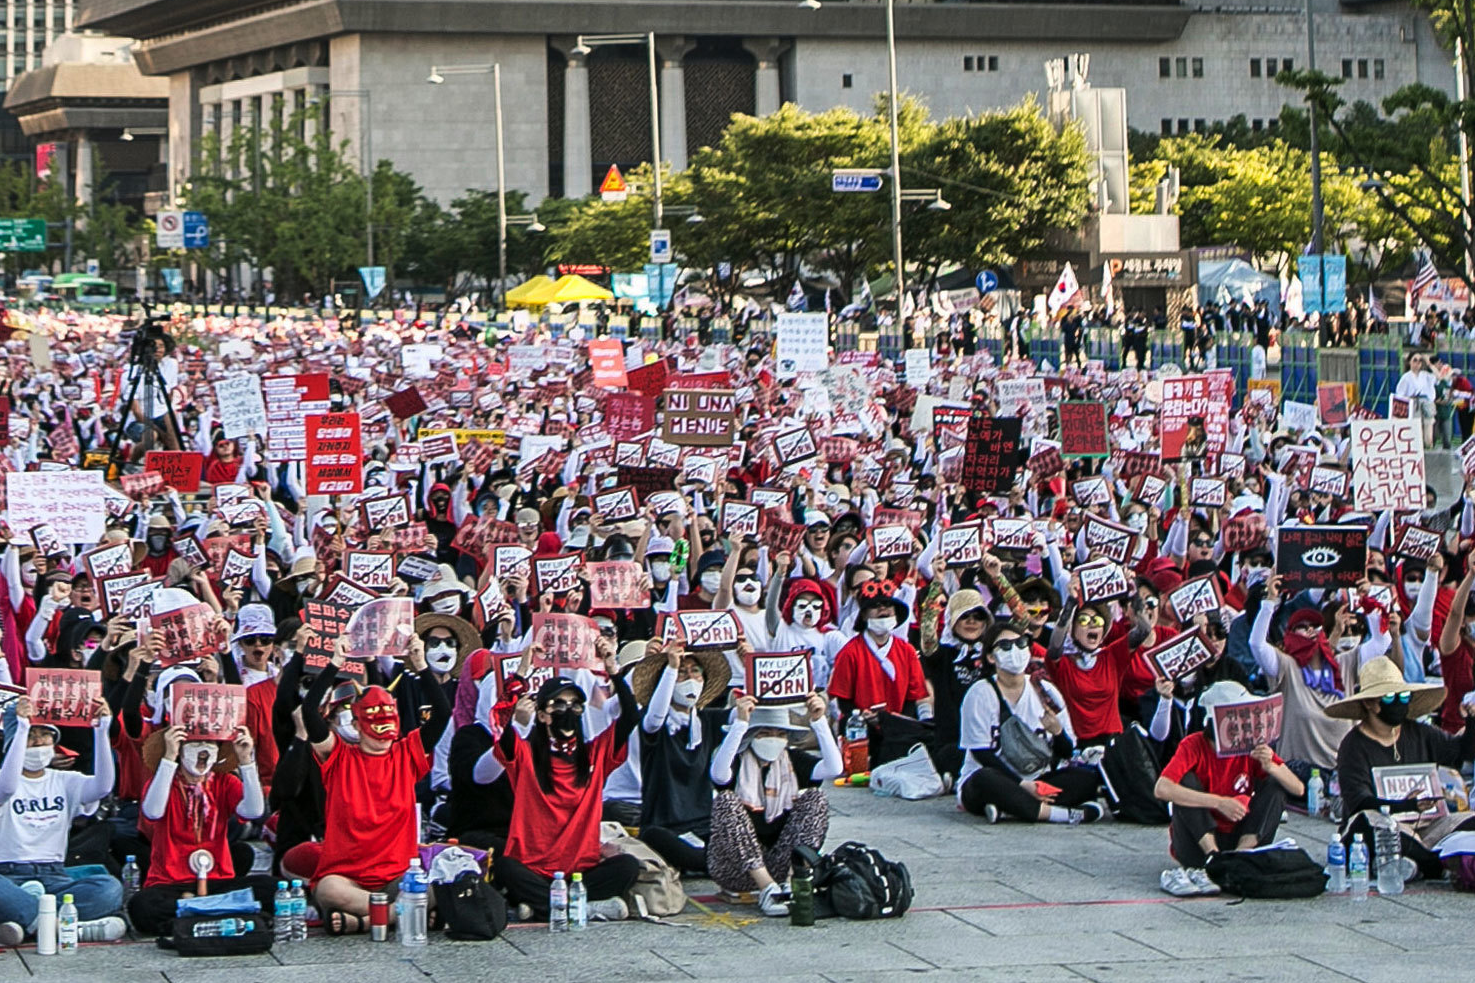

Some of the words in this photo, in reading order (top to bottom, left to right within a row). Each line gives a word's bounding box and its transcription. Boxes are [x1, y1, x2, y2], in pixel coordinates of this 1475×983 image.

[668, 394, 689, 411] NI
[697, 395, 735, 412] UNA
[670, 417, 729, 434] MENOS
[969, 429, 1003, 441] 노예가
[1357, 424, 1418, 455] 우리도
[1353, 457, 1423, 481] 사람답게
[1357, 481, 1425, 511] 살고싶다
[371, 512, 405, 527] PORN
[878, 542, 909, 555] PORN
[946, 540, 962, 548] NOT
[997, 536, 1028, 547] PORN
[947, 546, 978, 561] PORN
[1401, 542, 1432, 556] PORN
[499, 555, 516, 566] NOT
[539, 562, 552, 571] MY
[350, 572, 388, 586] PORN
[540, 570, 558, 579] NOT
[541, 576, 578, 593] PORN
[1086, 578, 1104, 587] NOT
[1087, 582, 1123, 599] PORN
[333, 591, 354, 605] NOT
[1181, 598, 1214, 620] PORN
[688, 629, 733, 644] PORN
[777, 659, 794, 668] LIFE
[1165, 652, 1186, 666] NOT
[1169, 648, 1208, 676] PORN
[759, 669, 779, 679] NOT
[759, 678, 804, 695] PORN
[12, 796, 64, 815] GRLS
